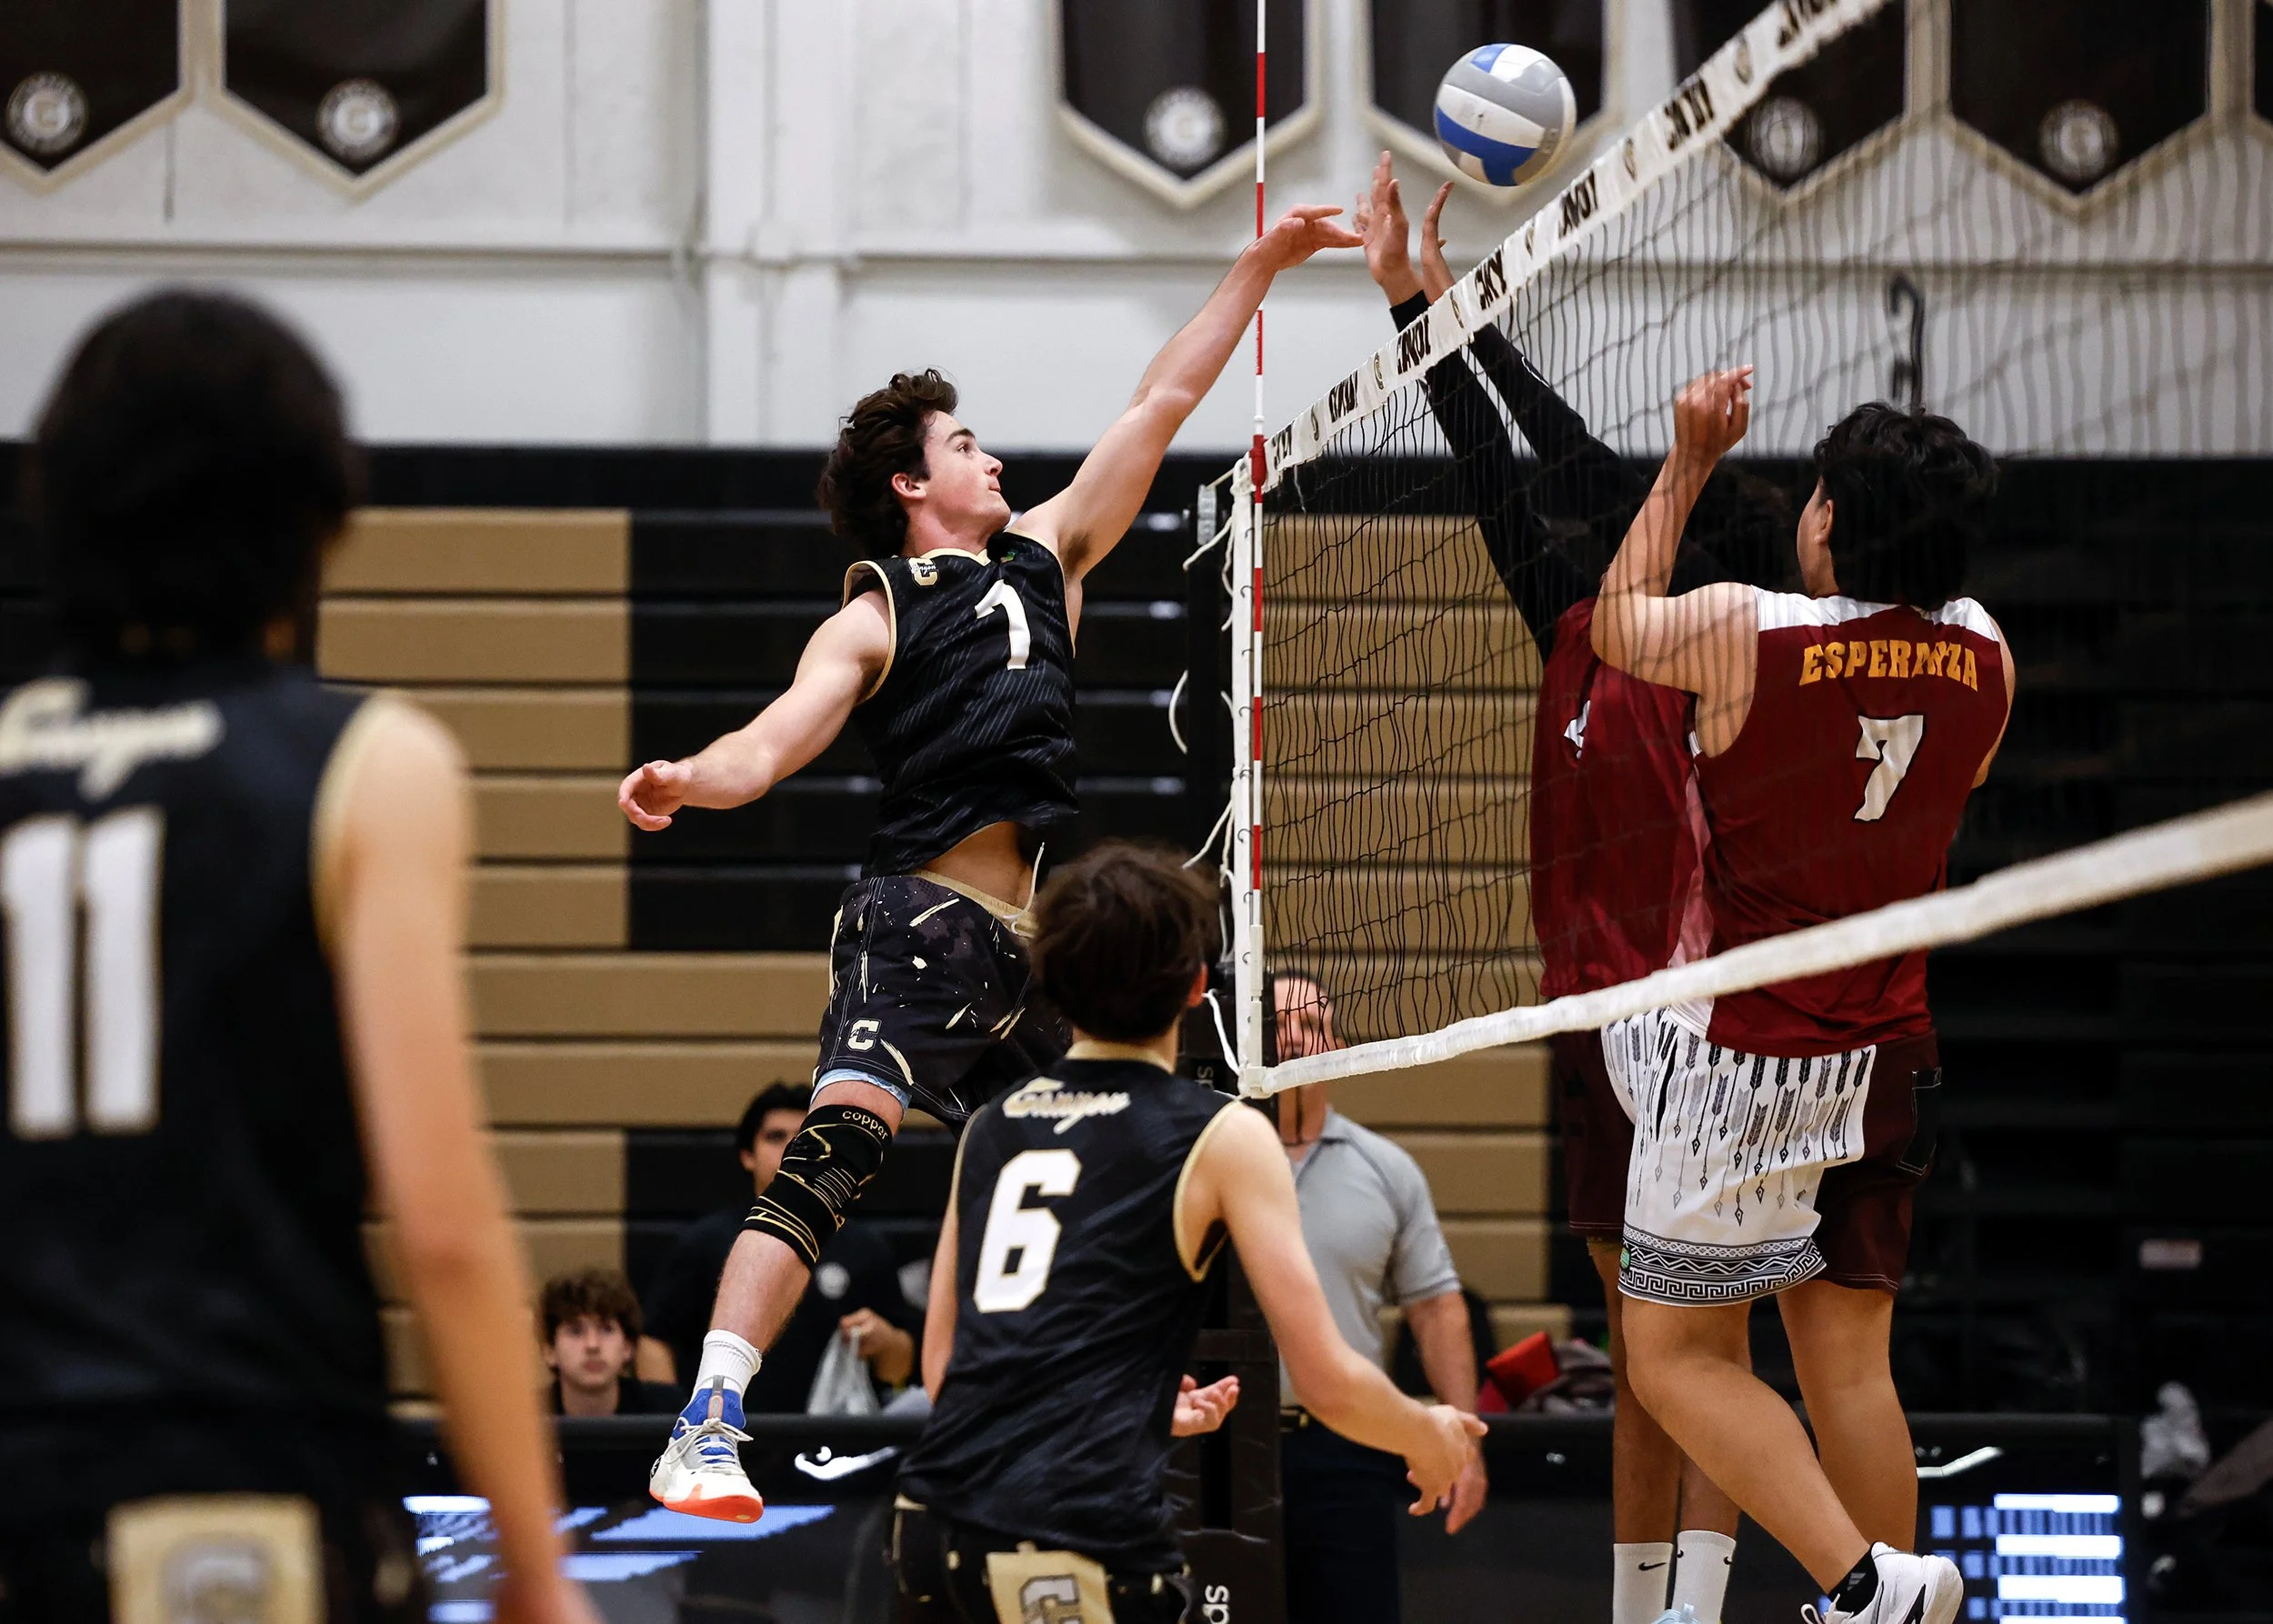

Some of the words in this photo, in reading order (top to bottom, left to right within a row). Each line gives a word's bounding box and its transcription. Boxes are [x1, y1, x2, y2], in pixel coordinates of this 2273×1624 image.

[974, 578, 1031, 671] 1
[1854, 715, 1924, 822] 7
[3, 809, 165, 1135] 11
[842, 1110, 889, 1140] copper
[973, 1148, 1083, 1314] 6
